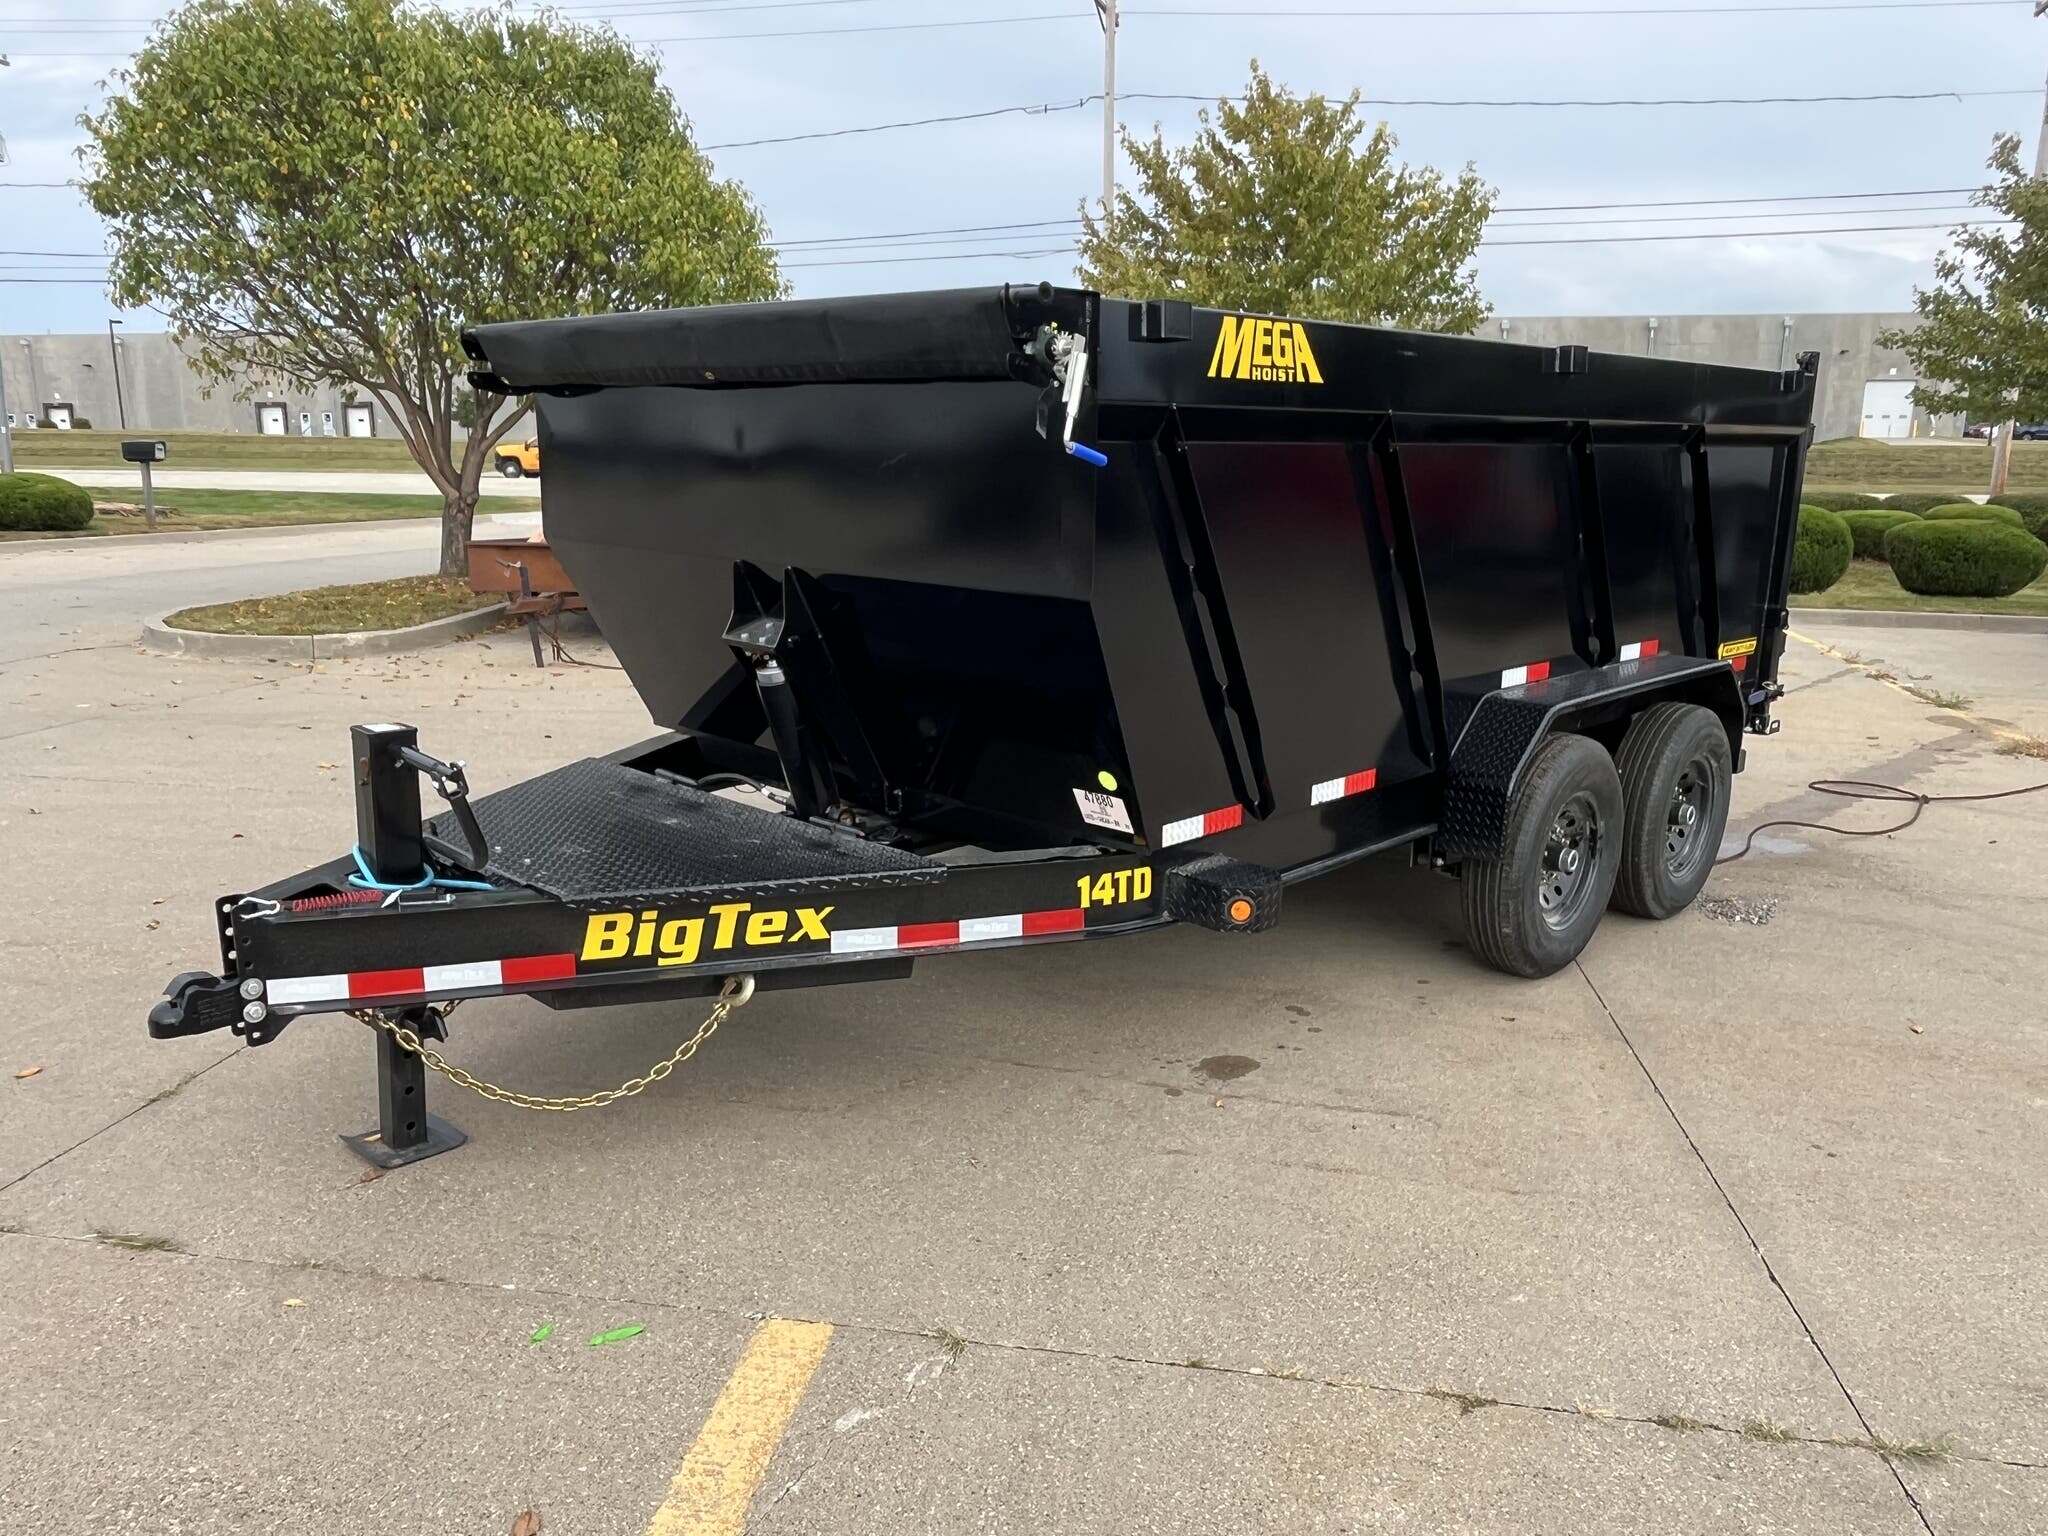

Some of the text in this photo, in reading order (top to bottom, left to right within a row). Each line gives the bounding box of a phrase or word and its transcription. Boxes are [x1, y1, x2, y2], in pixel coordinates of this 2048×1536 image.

[1207, 316, 1324, 383] MEGA
[1252, 366, 1295, 382] HOIST
[1077, 866, 1152, 909] 14TD
[581, 902, 835, 966] BigTex
